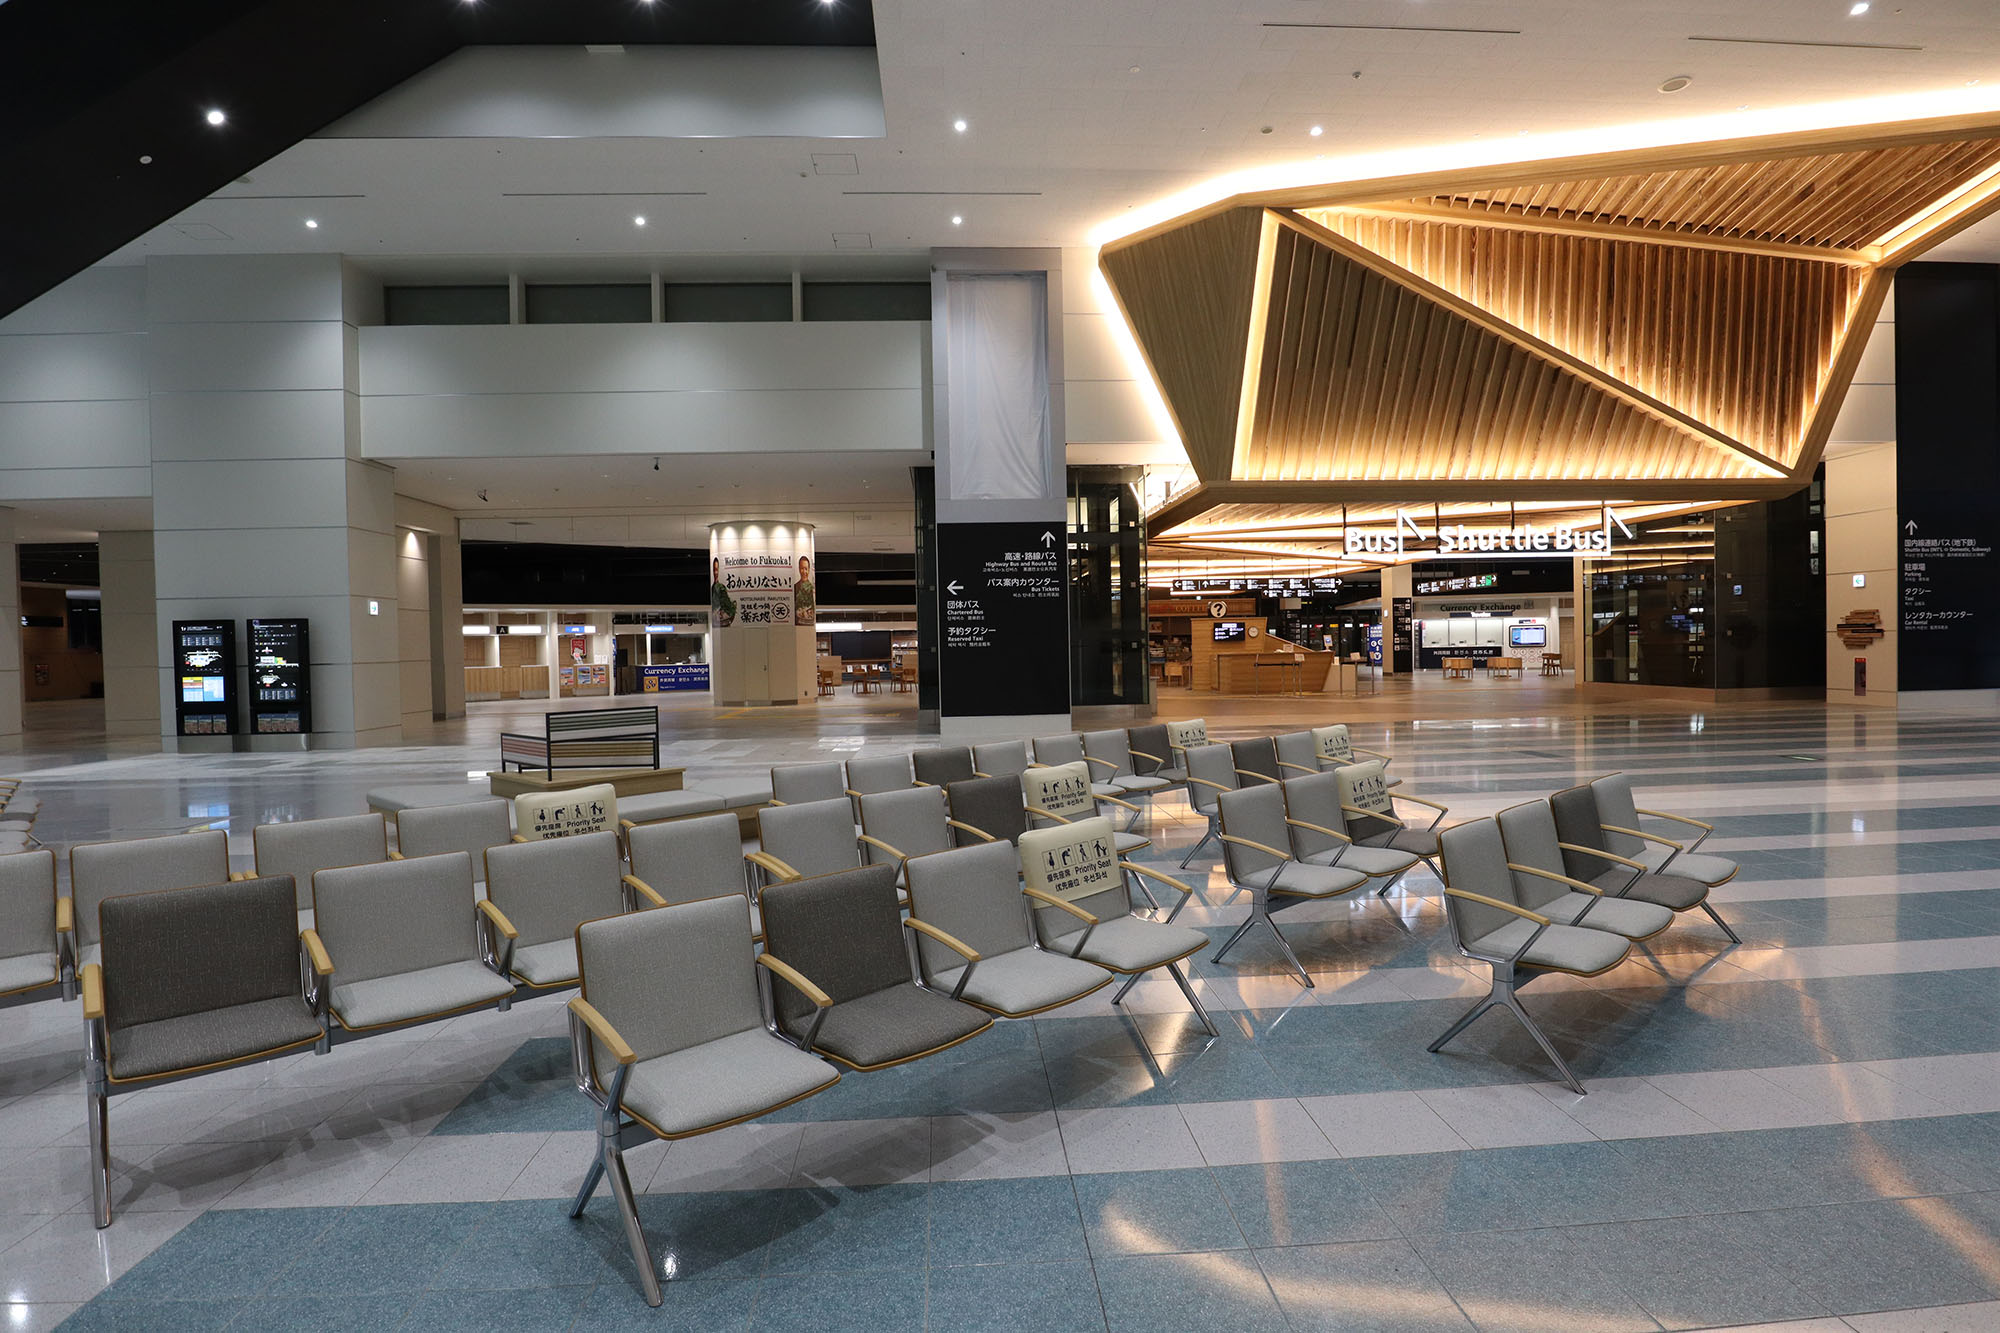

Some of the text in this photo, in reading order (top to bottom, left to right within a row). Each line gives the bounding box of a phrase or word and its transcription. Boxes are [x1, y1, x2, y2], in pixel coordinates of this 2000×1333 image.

[1345, 527, 1397, 552] Bus
[1438, 523, 1605, 552] Shuttle Bus
[724, 555, 791, 566] Welcome to Fukuoka!
[987, 578, 1060, 587] バス案内カウンター
[1904, 587, 1932, 595] タクシー
[946, 600, 980, 609] 団体バス
[1440, 602, 1522, 612] Currency Exchange
[1905, 610, 1974, 619] レンタカーカウンター
[947, 626, 996, 636] 予約タクシー
[678, 666, 709, 674] Exchange
[566, 816, 607, 828] Priority Seat
[1074, 859, 1112, 875] Priority Seat
